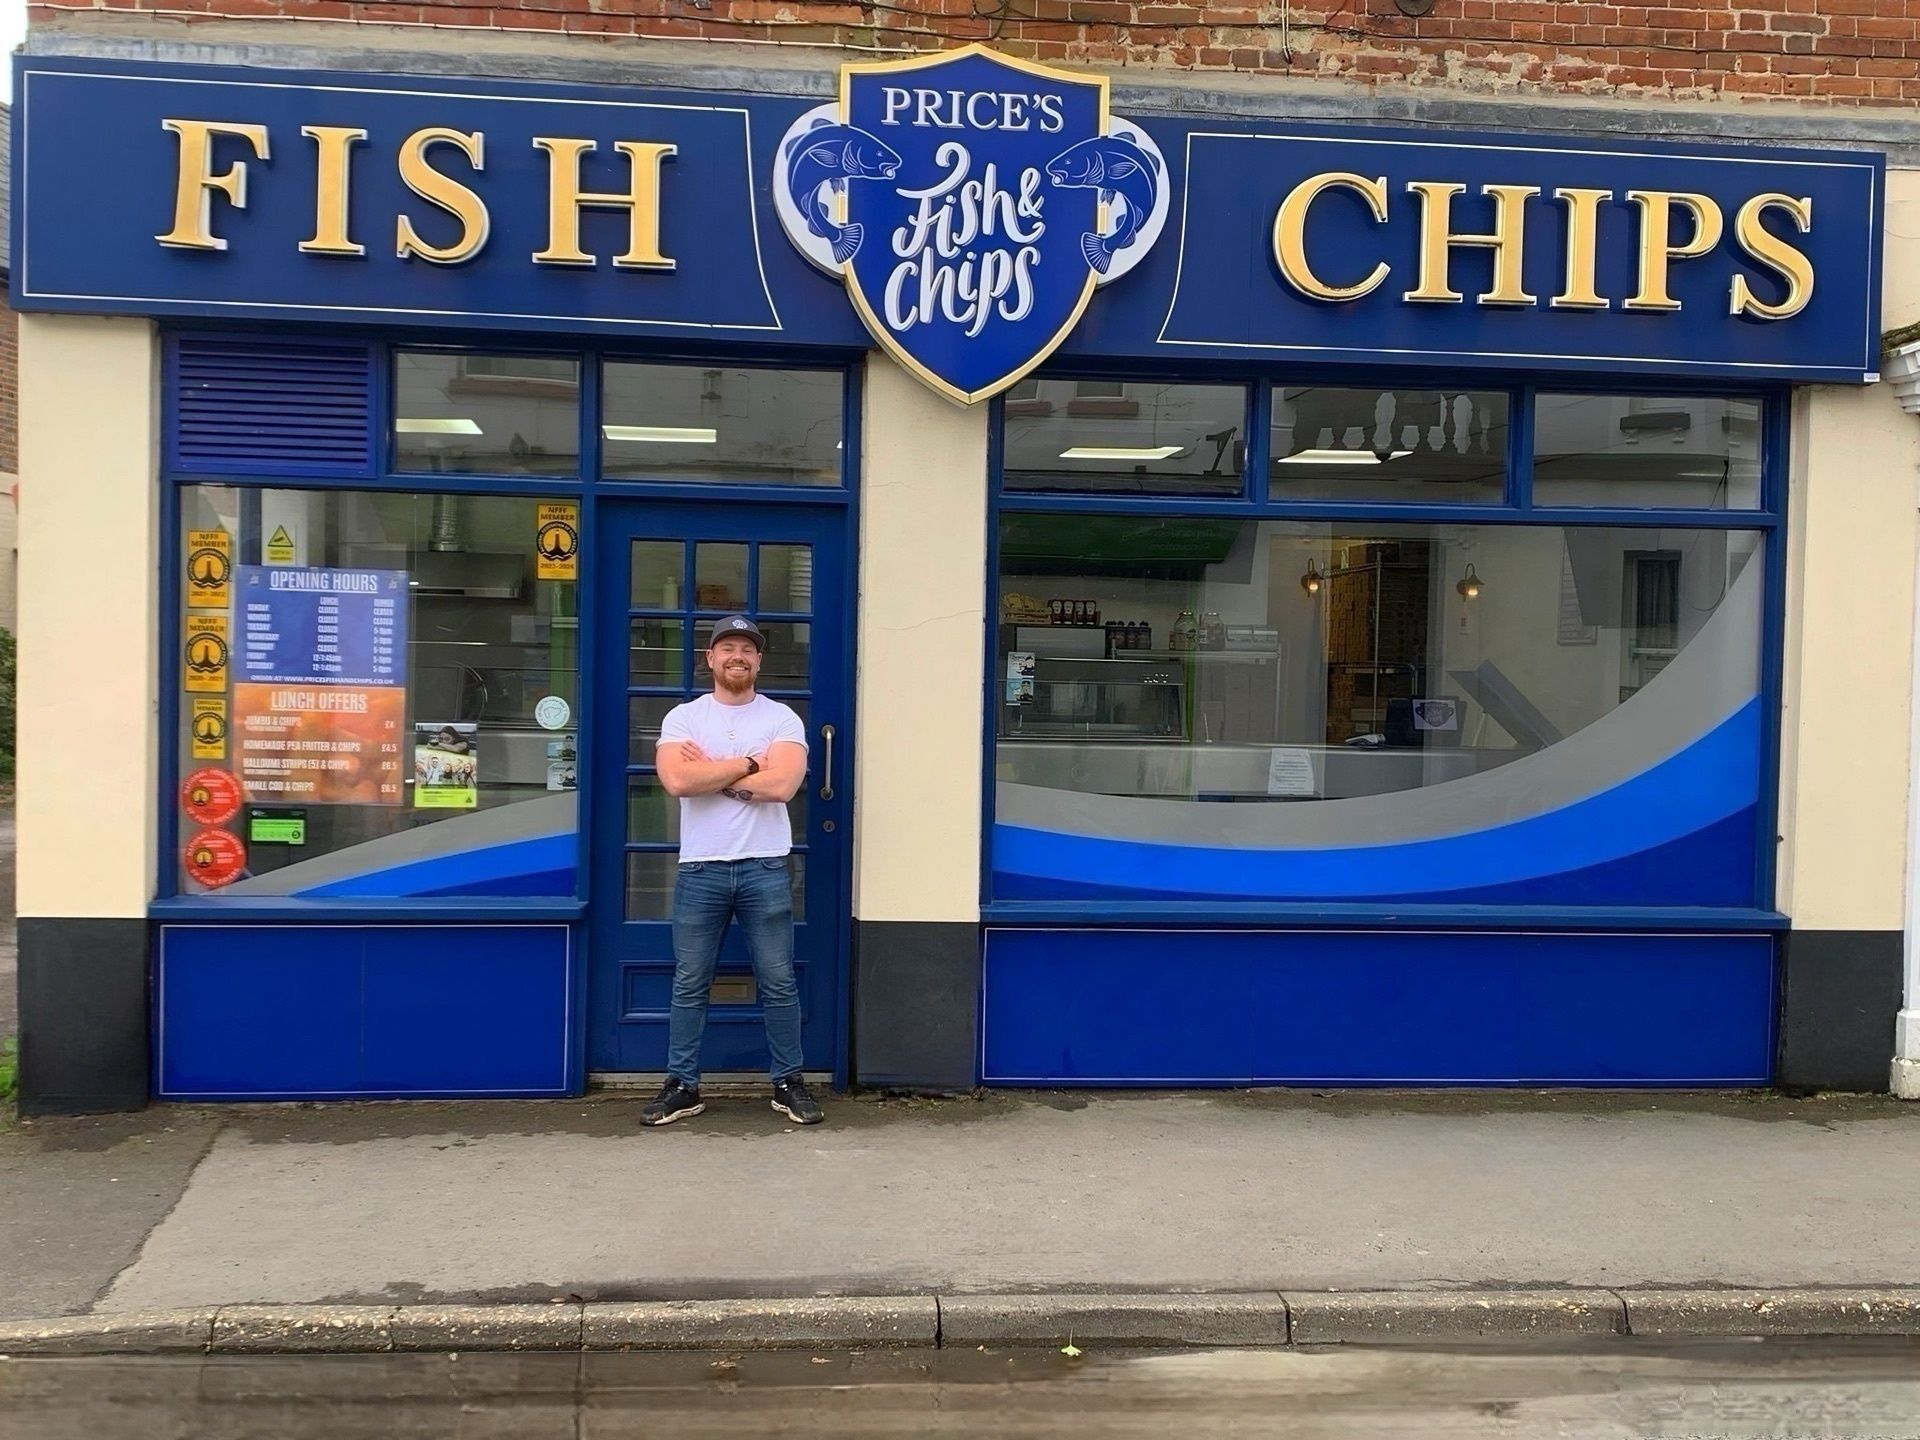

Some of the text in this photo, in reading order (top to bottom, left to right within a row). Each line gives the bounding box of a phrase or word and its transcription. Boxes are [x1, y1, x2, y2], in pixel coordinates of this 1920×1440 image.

[881, 87, 1065, 134] PRICE'S
[154, 118, 677, 269] FISH
[1017, 167, 1045, 218] &
[1272, 171, 1815, 320] CHIPS
[270, 571, 378, 591] OPENING HOURS
[272, 691, 368, 710] LUNCH OFFERS
[272, 716, 278, 726] &
[280, 716, 302, 727] CHIPS
[244, 740, 286, 750] HOMEMADE
[287, 741, 300, 750] PEA
[302, 742, 330, 752] FRITTER
[331, 742, 336, 752] &
[338, 742, 360, 752] CHIPS
[243, 758, 280, 768] HALLOUMI
[281, 758, 307, 768] STRIPS
[321, 760, 326, 769] &
[328, 760, 350, 770] CHIPS
[243, 780, 267, 790] SMALL
[268, 781, 283, 791] COD
[285, 782, 290, 791] &
[292, 782, 314, 792] CHIPS
